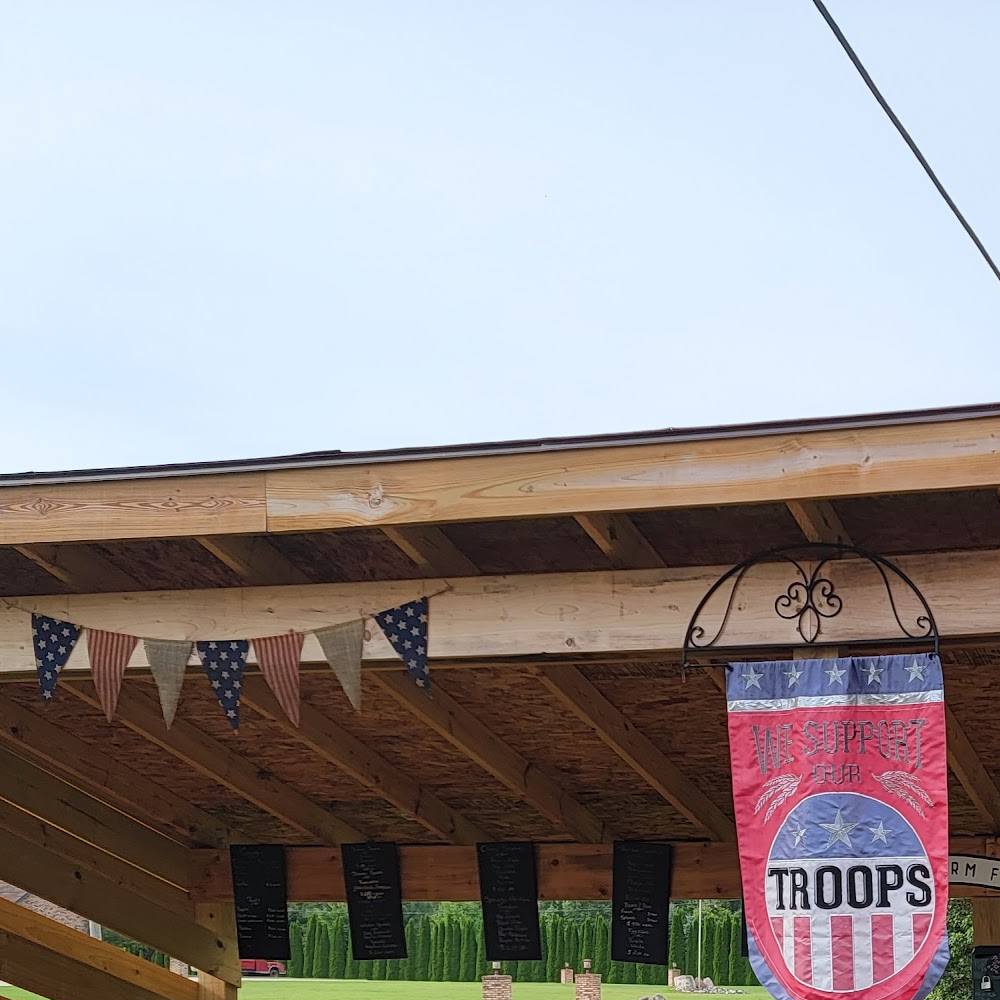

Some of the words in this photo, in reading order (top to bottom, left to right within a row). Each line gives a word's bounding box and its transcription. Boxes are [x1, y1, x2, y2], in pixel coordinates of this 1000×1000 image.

[752, 724, 795, 775] WE
[802, 718, 927, 770] SUPPORT
[812, 763, 863, 785] OUR
[767, 863, 932, 910] TROOPS
[951, 861, 977, 878] RM
